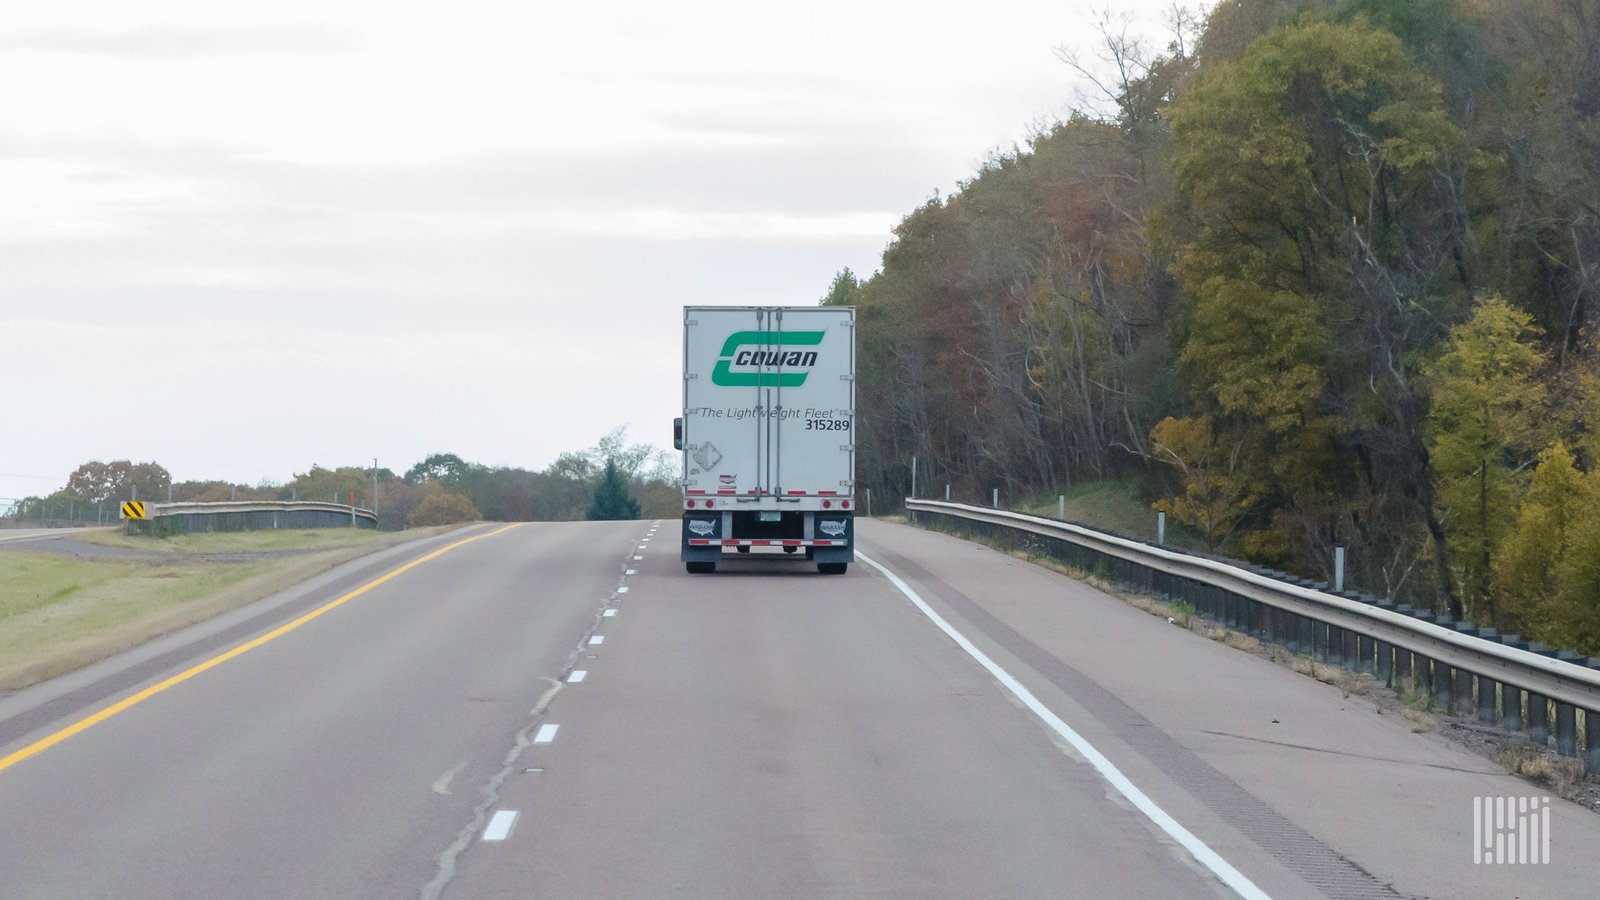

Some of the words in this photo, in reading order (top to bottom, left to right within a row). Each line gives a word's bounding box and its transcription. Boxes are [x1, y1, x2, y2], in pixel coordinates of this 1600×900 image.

[736, 351, 818, 366] cowan
[727, 407, 801, 421] Lightweght
[805, 419, 850, 431] 315289
